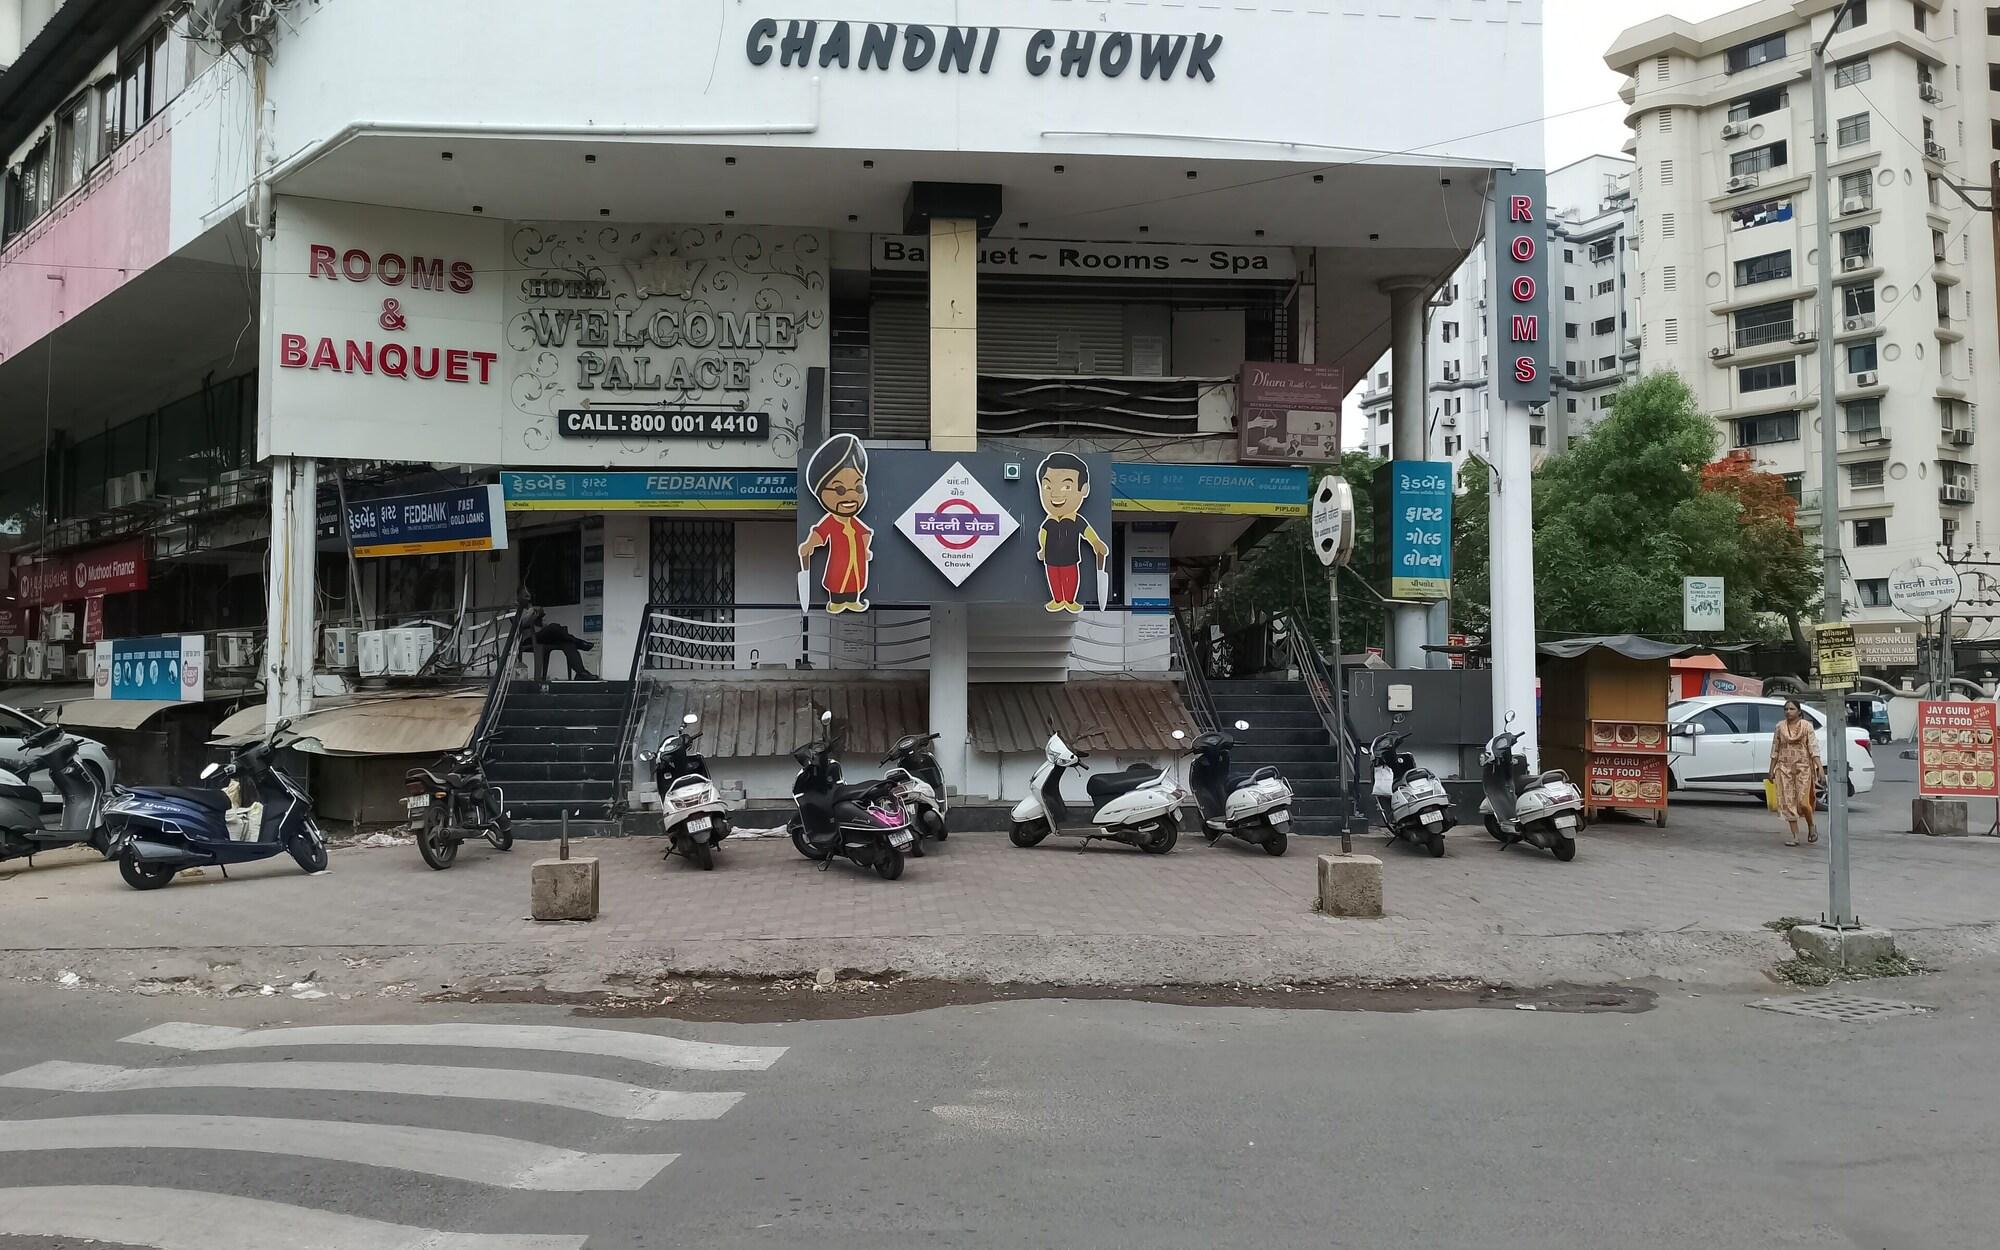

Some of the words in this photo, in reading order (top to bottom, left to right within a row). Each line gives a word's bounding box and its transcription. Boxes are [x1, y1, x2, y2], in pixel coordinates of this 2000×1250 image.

[746, 18, 1000, 74] CHANDNI
[1026, 29, 1223, 82] CHOWK
[309, 243, 474, 293] ROOMS
[1059, 249, 1170, 270] Rooms
[1209, 250, 1269, 274] Spa
[529, 278, 611, 299] HOTEL
[1509, 194, 1538, 382] ROOMS
[378, 297, 407, 331] &
[528, 307, 798, 349] WELCOME
[280, 332, 498, 384] BANQUET
[577, 355, 750, 391] PALACE
[1252, 368, 1286, 387] Dhara
[671, 415, 705, 432] 001
[711, 415, 759, 433] 4410
[646, 476, 735, 490] FEDBANK
[757, 476, 787, 484] FAST
[1198, 475, 1256, 487] FEDBANK
[404, 502, 447, 524] FEDBANK
[457, 498, 474, 511] FAST
[451, 514, 465, 525] GOLD
[466, 512, 484, 524] LOANS
[1406, 507, 1443, 522] ફાસ્ટ
[920, 517, 960, 531] चाँदनी
[1405, 528, 1441, 545] ગોલ્ડ
[1403, 549, 1442, 566] લોન્સ
[88, 562, 112, 580] Muthoot
[113, 560, 135, 577] Finance
[1906, 590, 1934, 598] welcome
[1876, 636, 1914, 644] SANKUL
[1927, 706, 1943, 714] JAY
[1945, 706, 1970, 715] GURU
[1925, 717, 1946, 725] FAST
[1949, 717, 1972, 726] FOOD
[1594, 757, 1611, 765] JAY
[1614, 758, 1640, 766] GURU
[1592, 767, 1614, 776] FAST
[1616, 768, 1641, 777] FOOD
